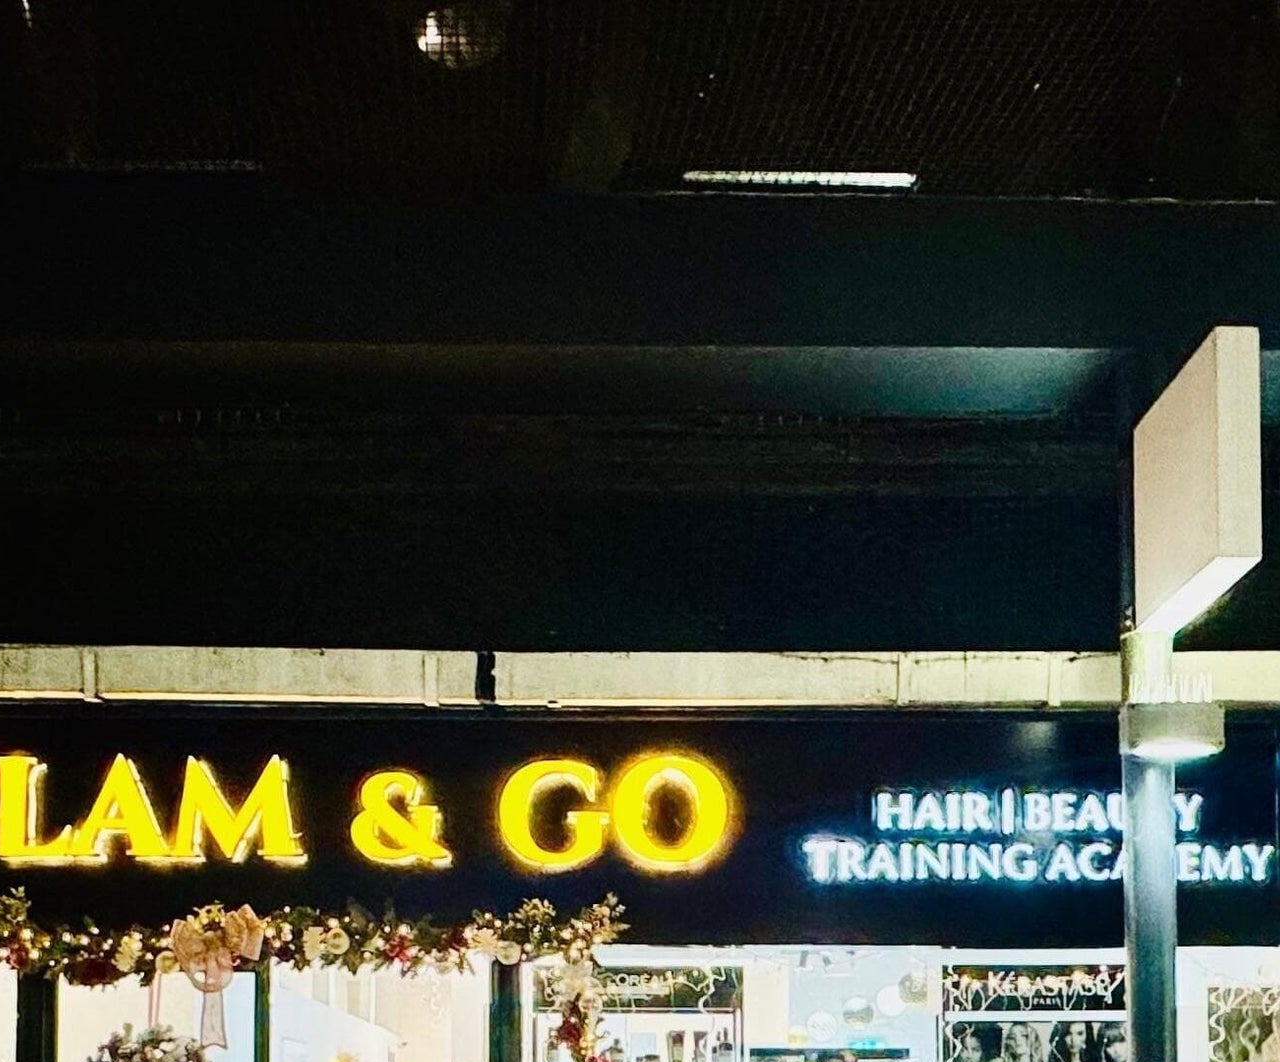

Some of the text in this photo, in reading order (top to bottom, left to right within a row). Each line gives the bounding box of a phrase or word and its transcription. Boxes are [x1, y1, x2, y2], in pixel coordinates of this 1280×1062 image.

[350, 770, 453, 868] &
[499, 755, 732, 874] GO
[876, 791, 993, 832] HAIR
[1023, 791, 1204, 832] BEAUY
[802, 840, 1275, 882] TRAINING ACEMY
